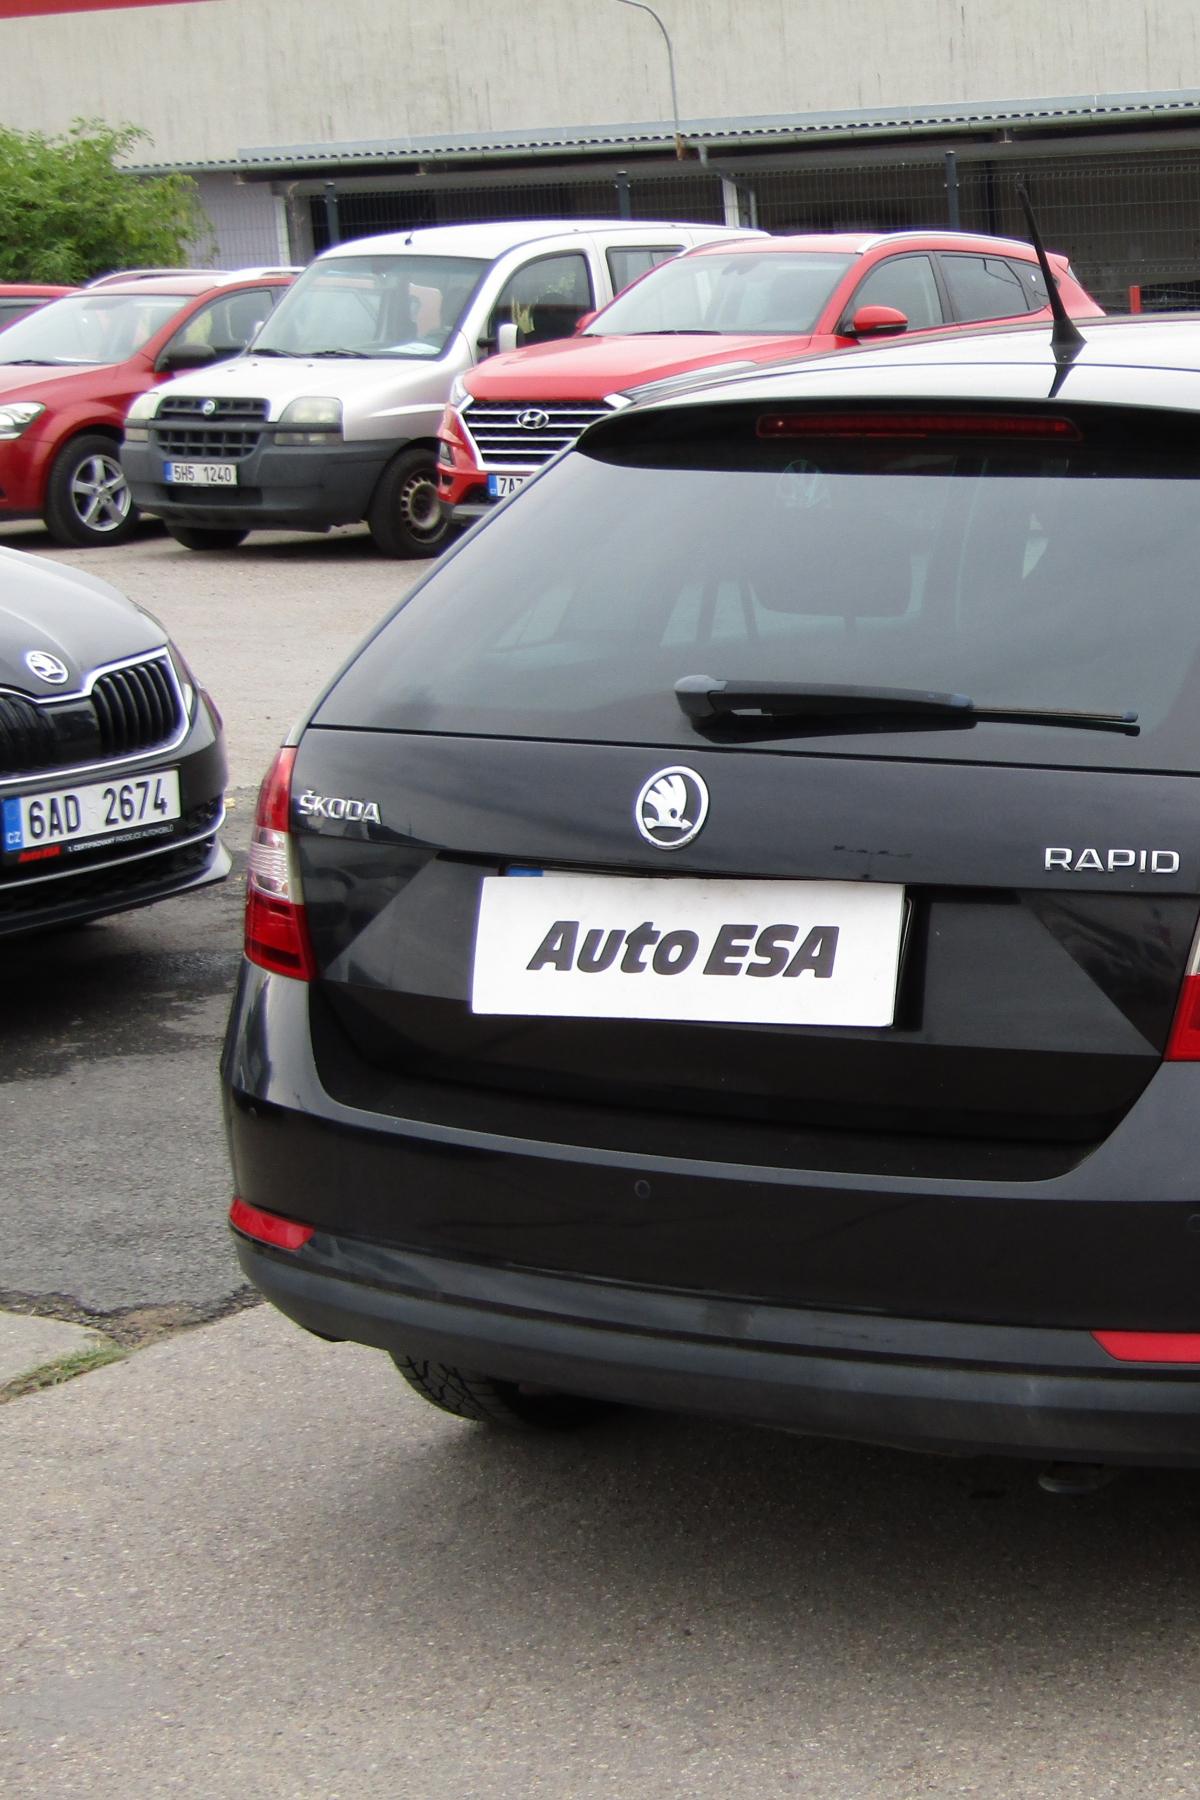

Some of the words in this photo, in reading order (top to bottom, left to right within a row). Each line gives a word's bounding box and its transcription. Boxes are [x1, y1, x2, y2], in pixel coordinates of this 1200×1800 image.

[174, 465, 195, 481] 5H5
[204, 466, 232, 482] 1240
[29, 795, 82, 839] 6AD
[103, 778, 168, 826] 2674
[298, 789, 382, 825] ŠKODA
[7, 831, 21, 844] CZ
[1044, 847, 1180, 874] RAPID
[526, 920, 700, 976] Auto
[702, 923, 840, 978] ESA
